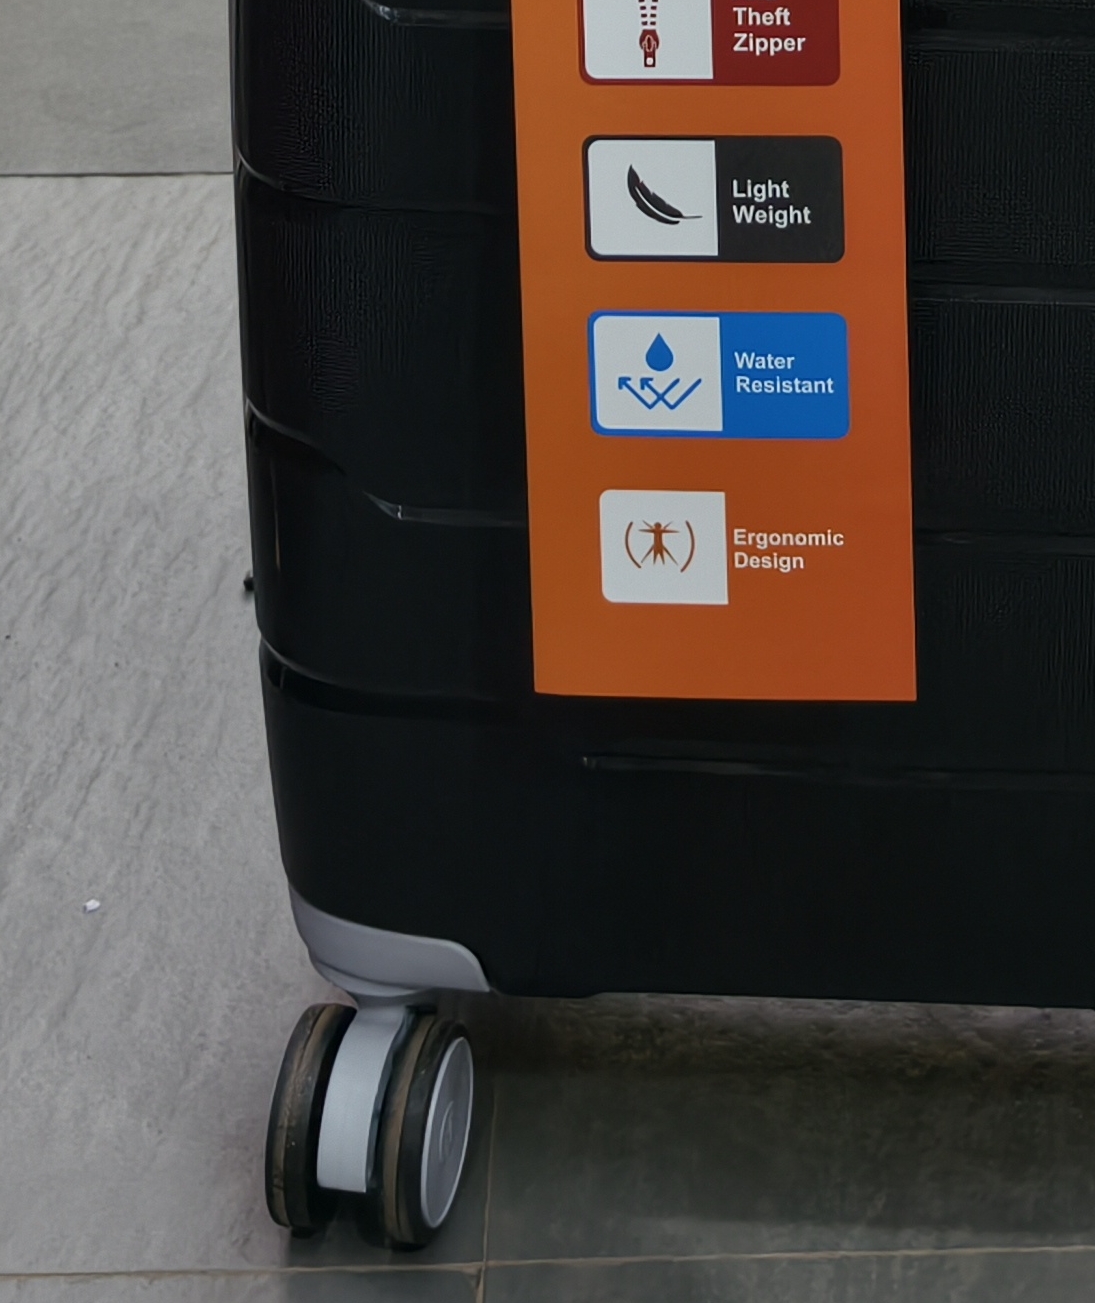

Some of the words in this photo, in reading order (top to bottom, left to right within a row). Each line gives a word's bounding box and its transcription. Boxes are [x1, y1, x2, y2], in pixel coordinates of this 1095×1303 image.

[732, 6, 791, 26] Theft
[732, 32, 807, 56] Zipper
[732, 178, 791, 203] Light
[732, 204, 812, 229] Weight
[734, 351, 796, 370] Water
[735, 375, 835, 394] Resistant
[733, 528, 845, 550] Ergonomic
[733, 551, 805, 573] Design
